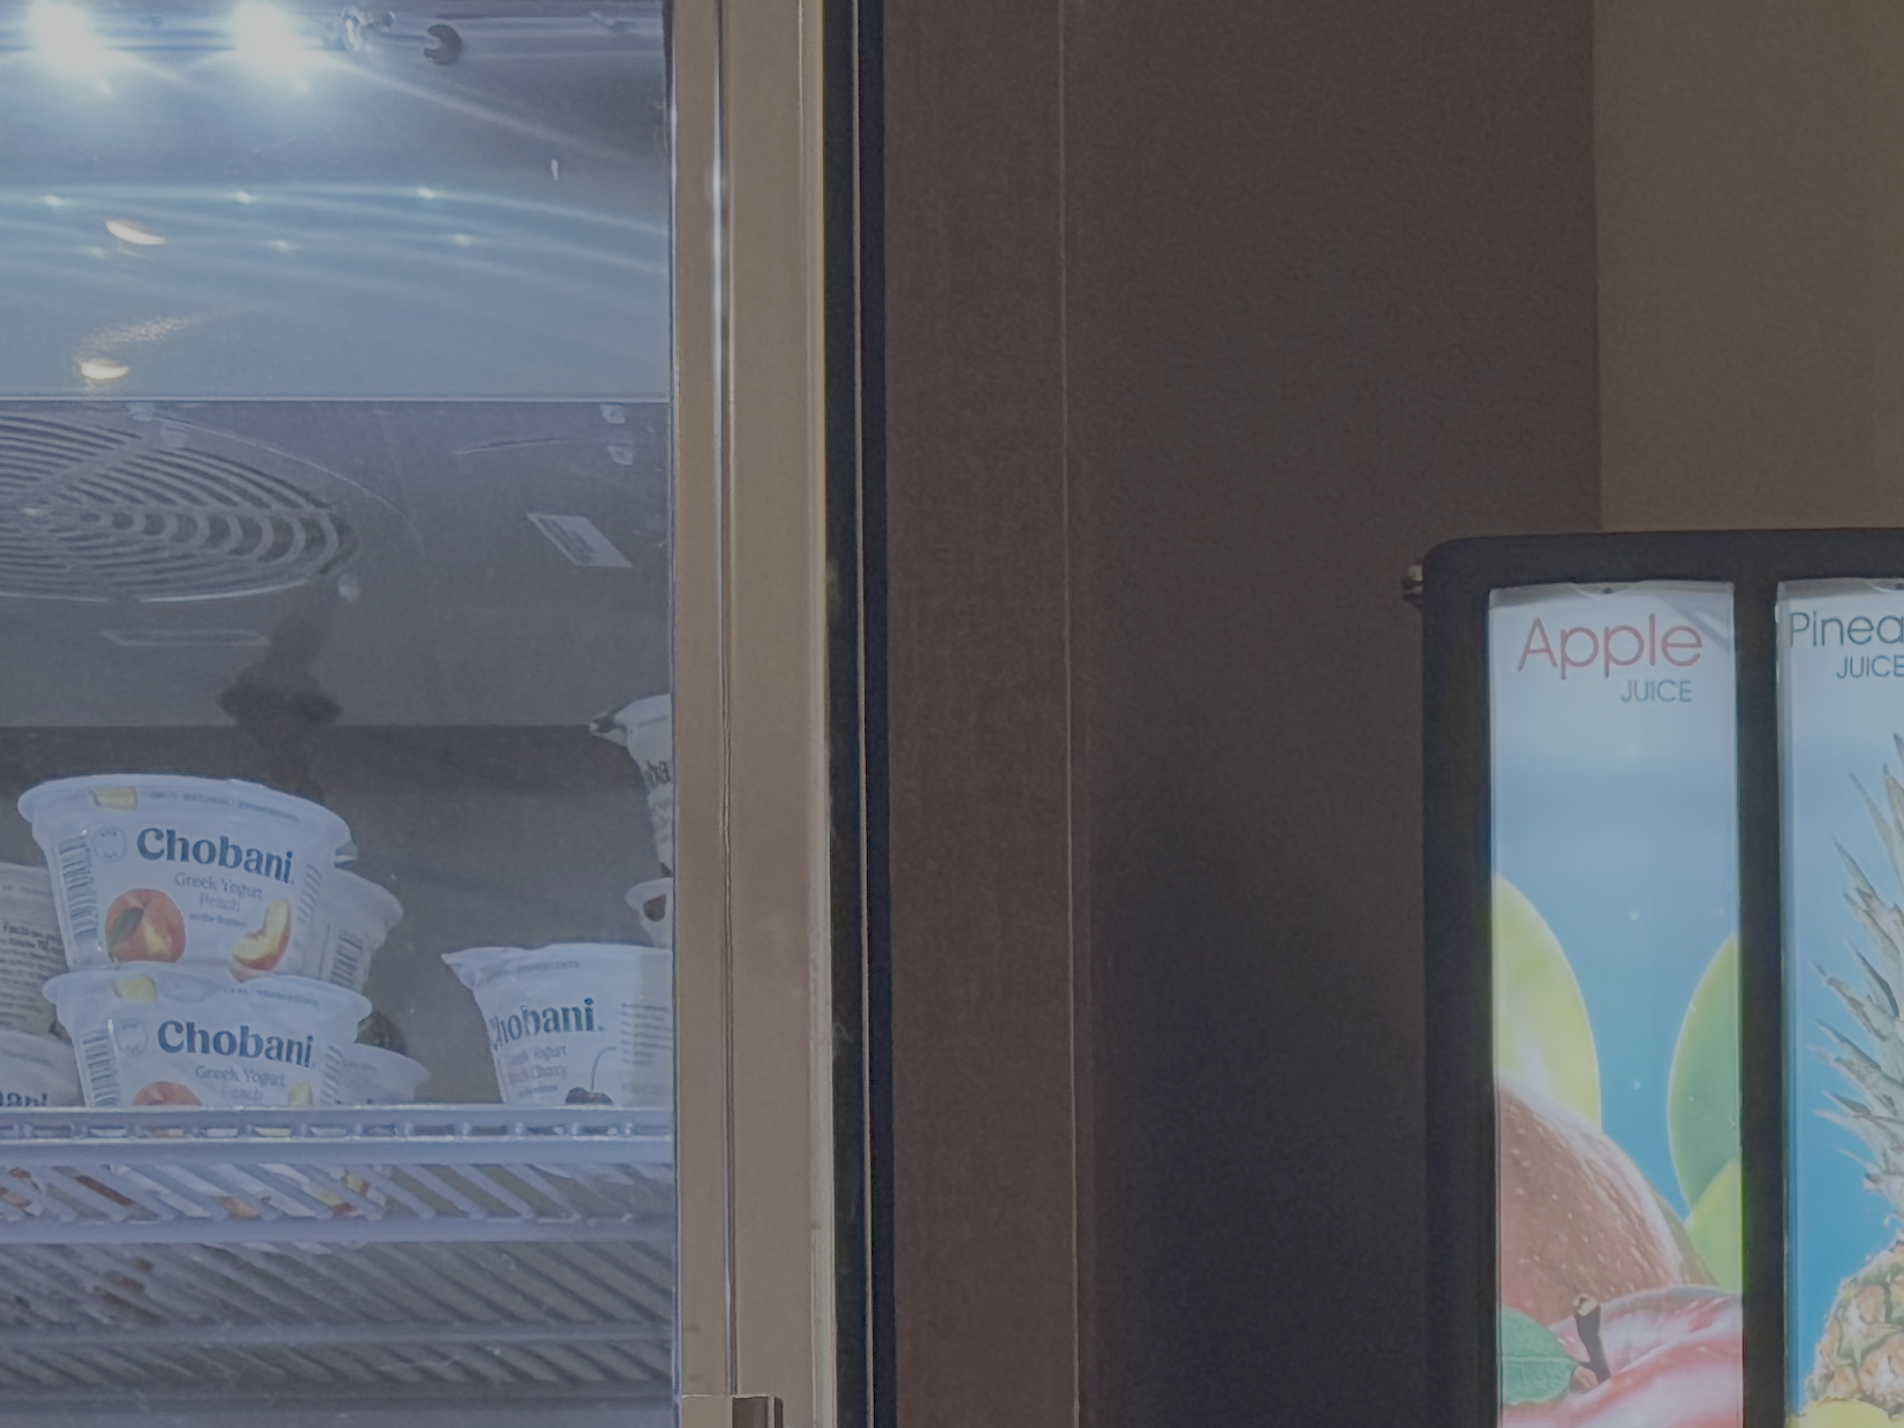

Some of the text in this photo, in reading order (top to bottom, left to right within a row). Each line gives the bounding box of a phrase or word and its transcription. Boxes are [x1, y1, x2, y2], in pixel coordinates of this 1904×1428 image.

[1517, 612, 1704, 680] Apple
[1618, 679, 1693, 703] JUICE
[136, 827, 294, 885] Chobani
[157, 1019, 315, 1069] Chobani
